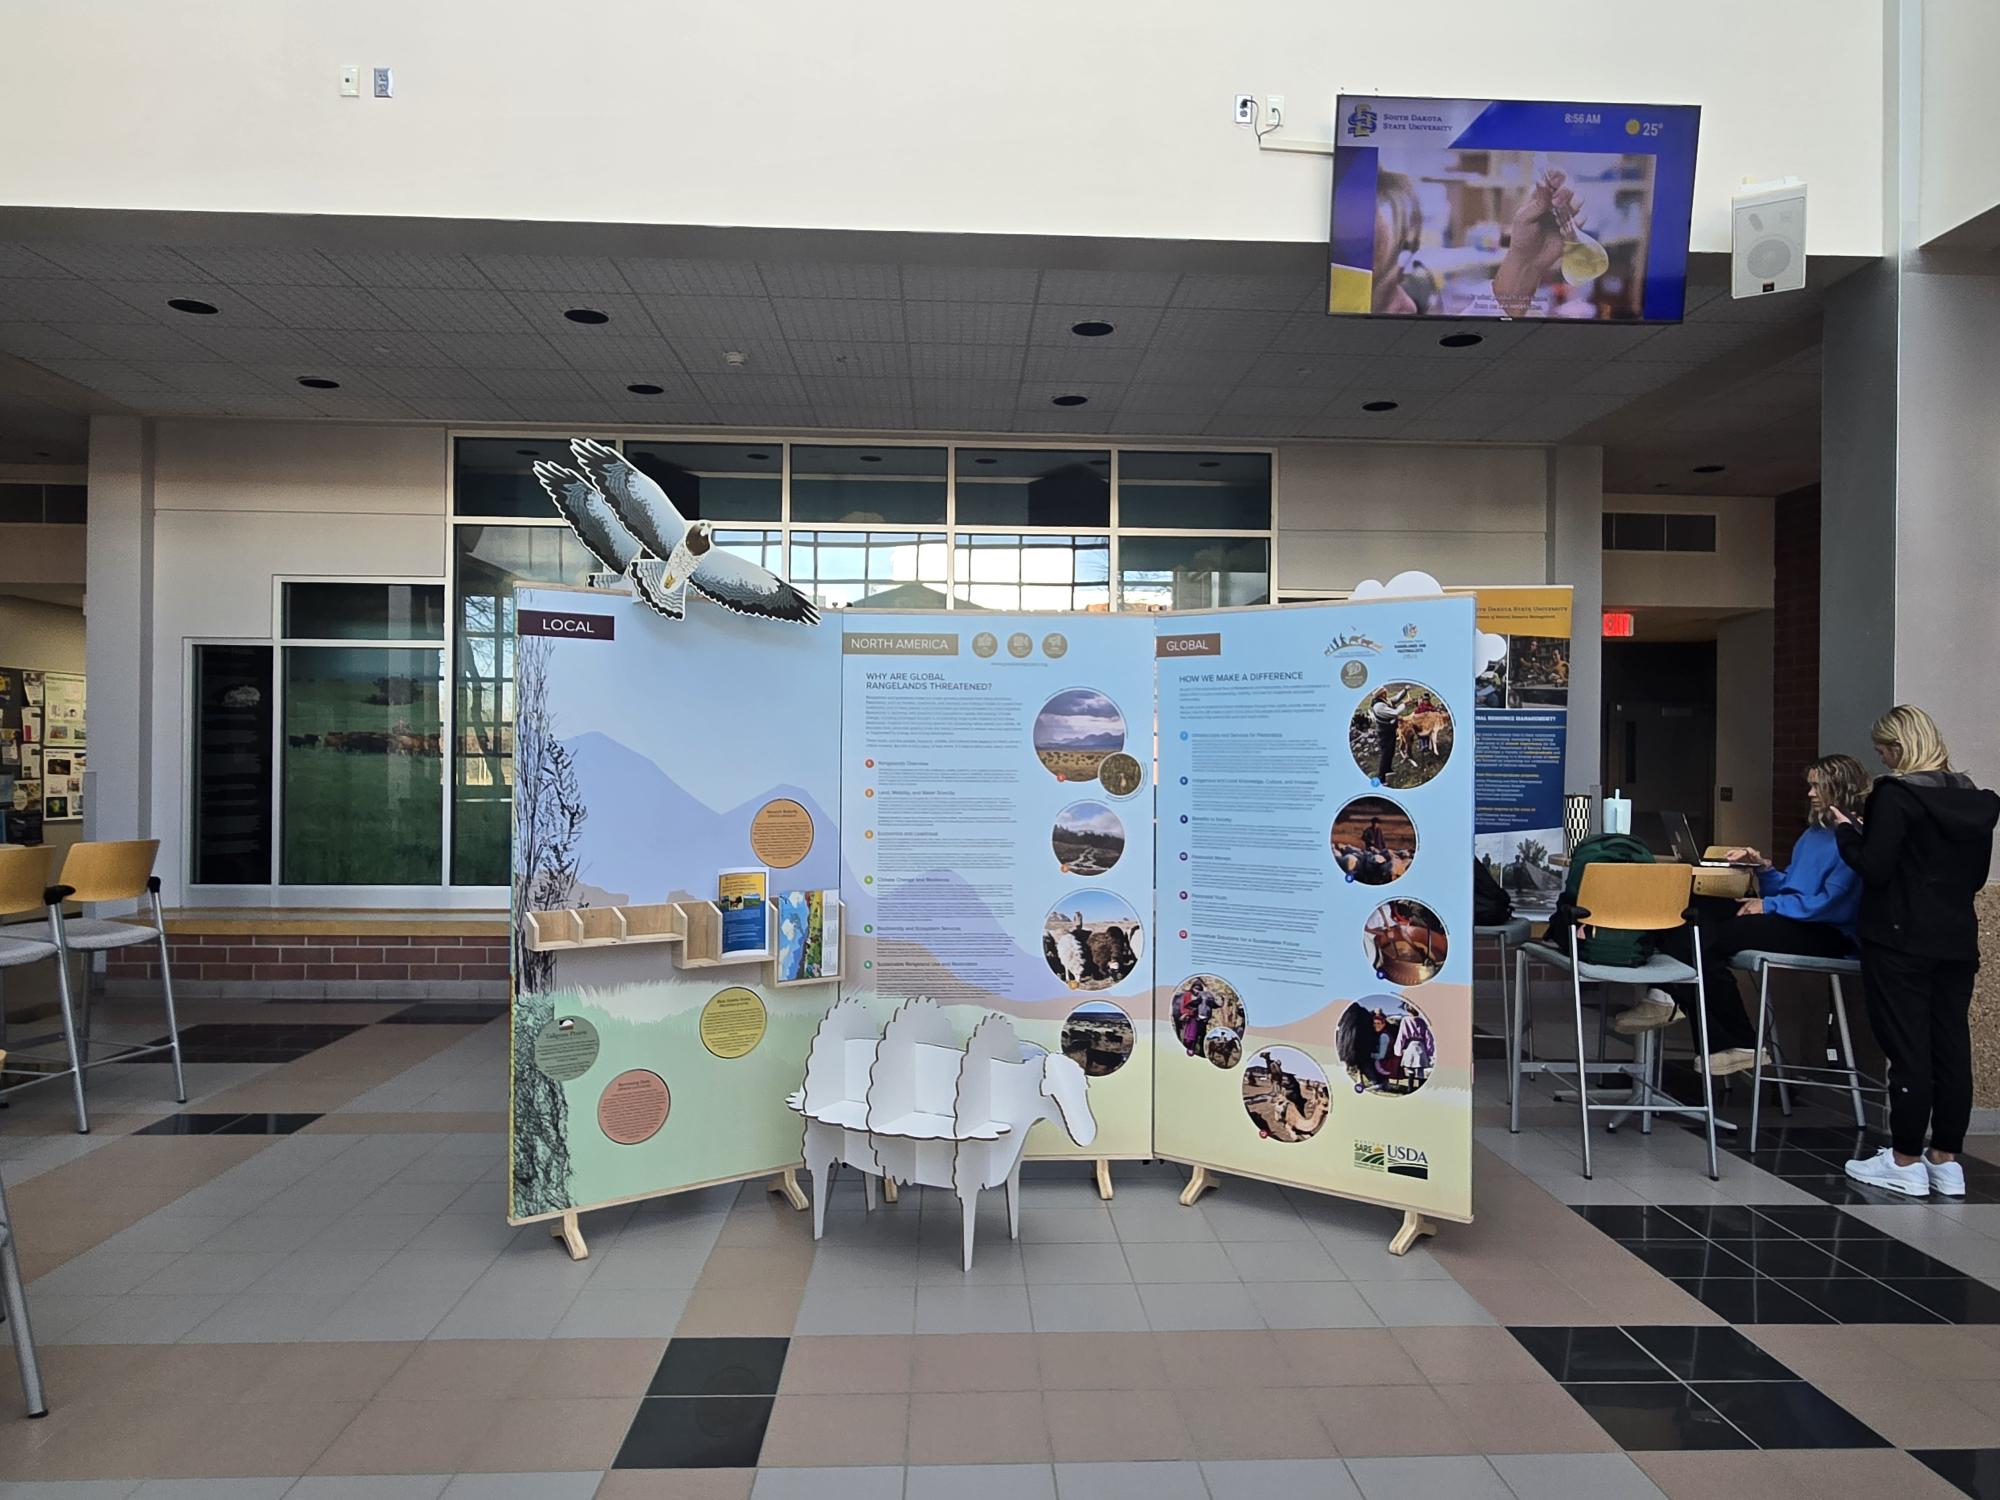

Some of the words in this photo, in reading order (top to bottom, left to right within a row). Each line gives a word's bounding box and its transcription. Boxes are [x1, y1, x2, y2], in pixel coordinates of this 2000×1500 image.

[1585, 113, 1601, 124] AM
[542, 618, 595, 633] LOCAL
[850, 638, 893, 649] NORTH
[895, 638, 949, 650] AMERICA
[1166, 640, 1209, 651] GLOBAL
[866, 672, 888, 681] WHY
[889, 672, 908, 681] ARE
[909, 672, 945, 681] GLOBAL
[1179, 674, 1200, 683] HOW
[1201, 674, 1214, 682] WE
[1216, 673, 1240, 682] MAKE
[1242, 673, 1249, 681] A
[1250, 671, 1303, 681] DIFFERENCE
[865, 682, 928, 690] RANGELANDS
[930, 682, 993, 691] THREATENED?
[1387, 1144, 1428, 1164] USDA
